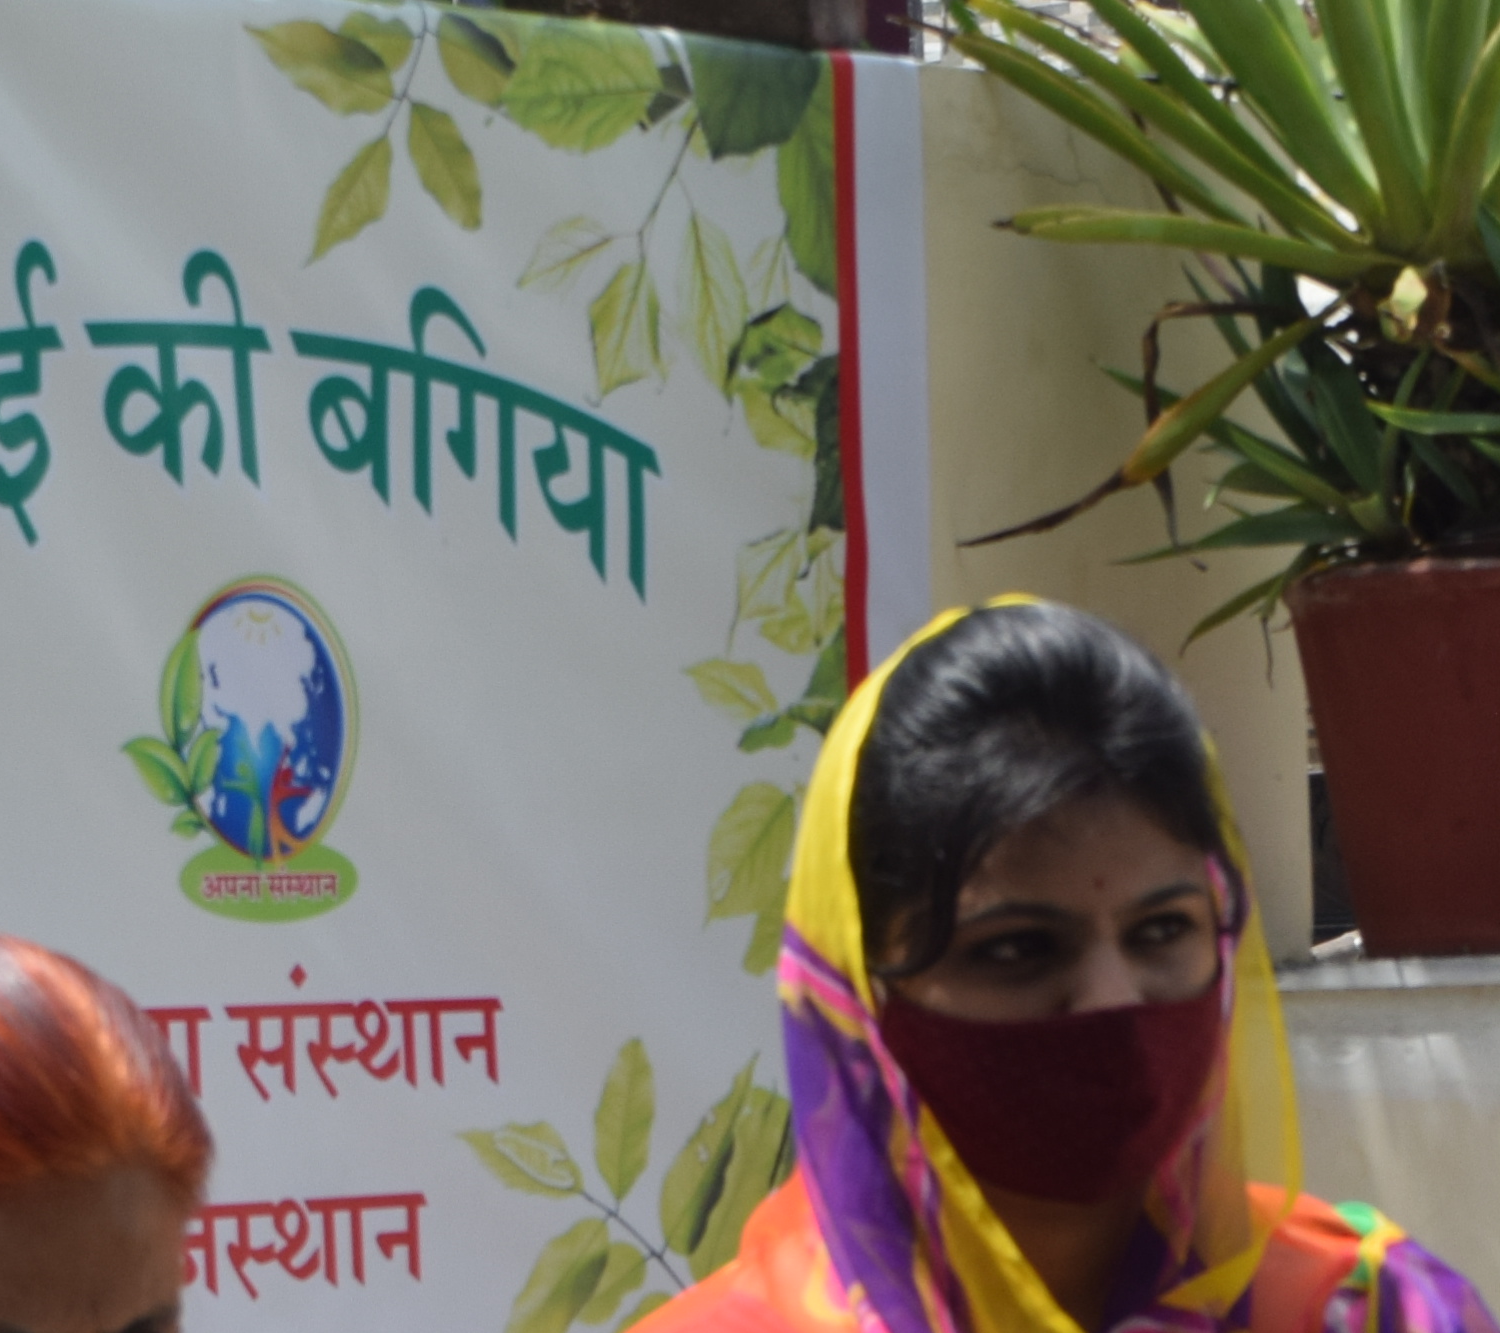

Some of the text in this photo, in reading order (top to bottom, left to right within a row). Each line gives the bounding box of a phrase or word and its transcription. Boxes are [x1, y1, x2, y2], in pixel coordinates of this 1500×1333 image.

[85, 248, 270, 490] की
[289, 285, 661, 603] बगिया
[202, 872, 261, 900] अपना
[224, 963, 504, 1101] संस्थान
